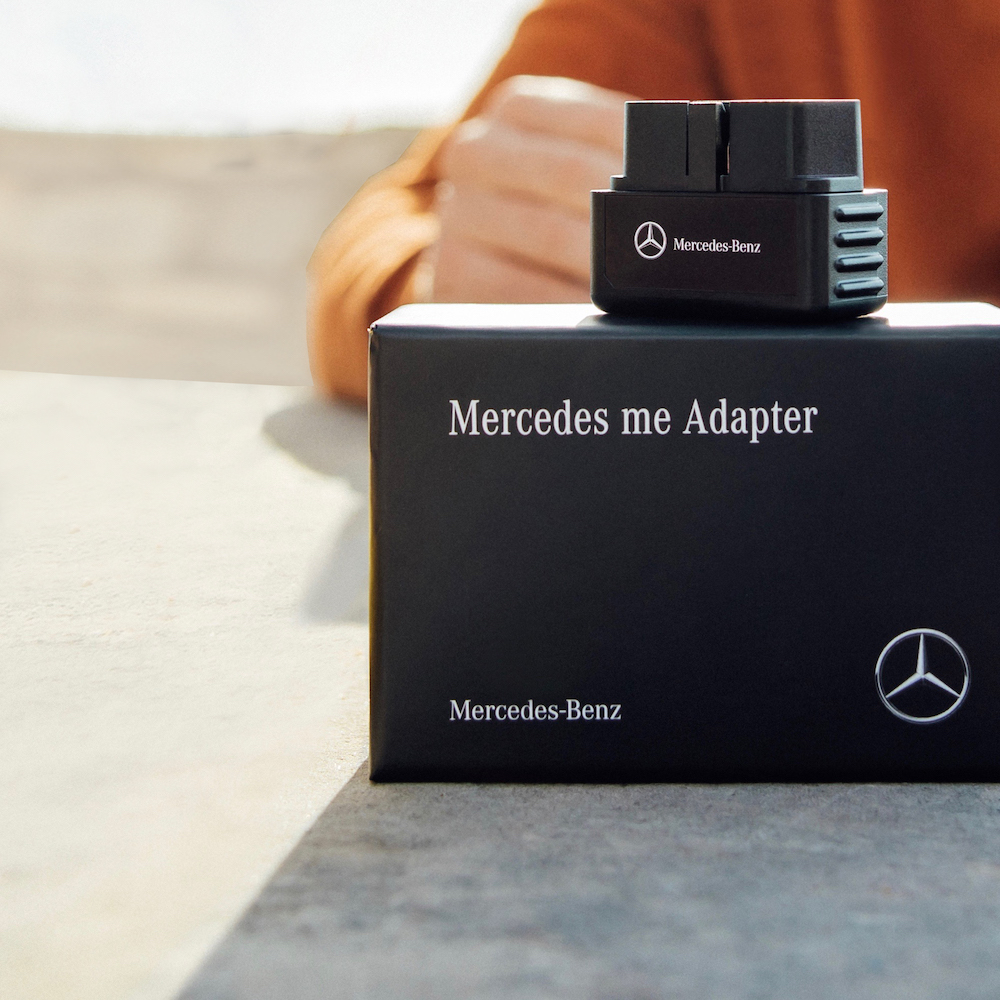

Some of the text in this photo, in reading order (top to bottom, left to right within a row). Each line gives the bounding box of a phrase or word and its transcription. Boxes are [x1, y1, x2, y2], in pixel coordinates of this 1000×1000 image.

[673, 237, 761, 254] Mercedes-Benz
[448, 397, 819, 444] Mercedes me Adapter
[449, 698, 622, 722] Mercedes-Benz
